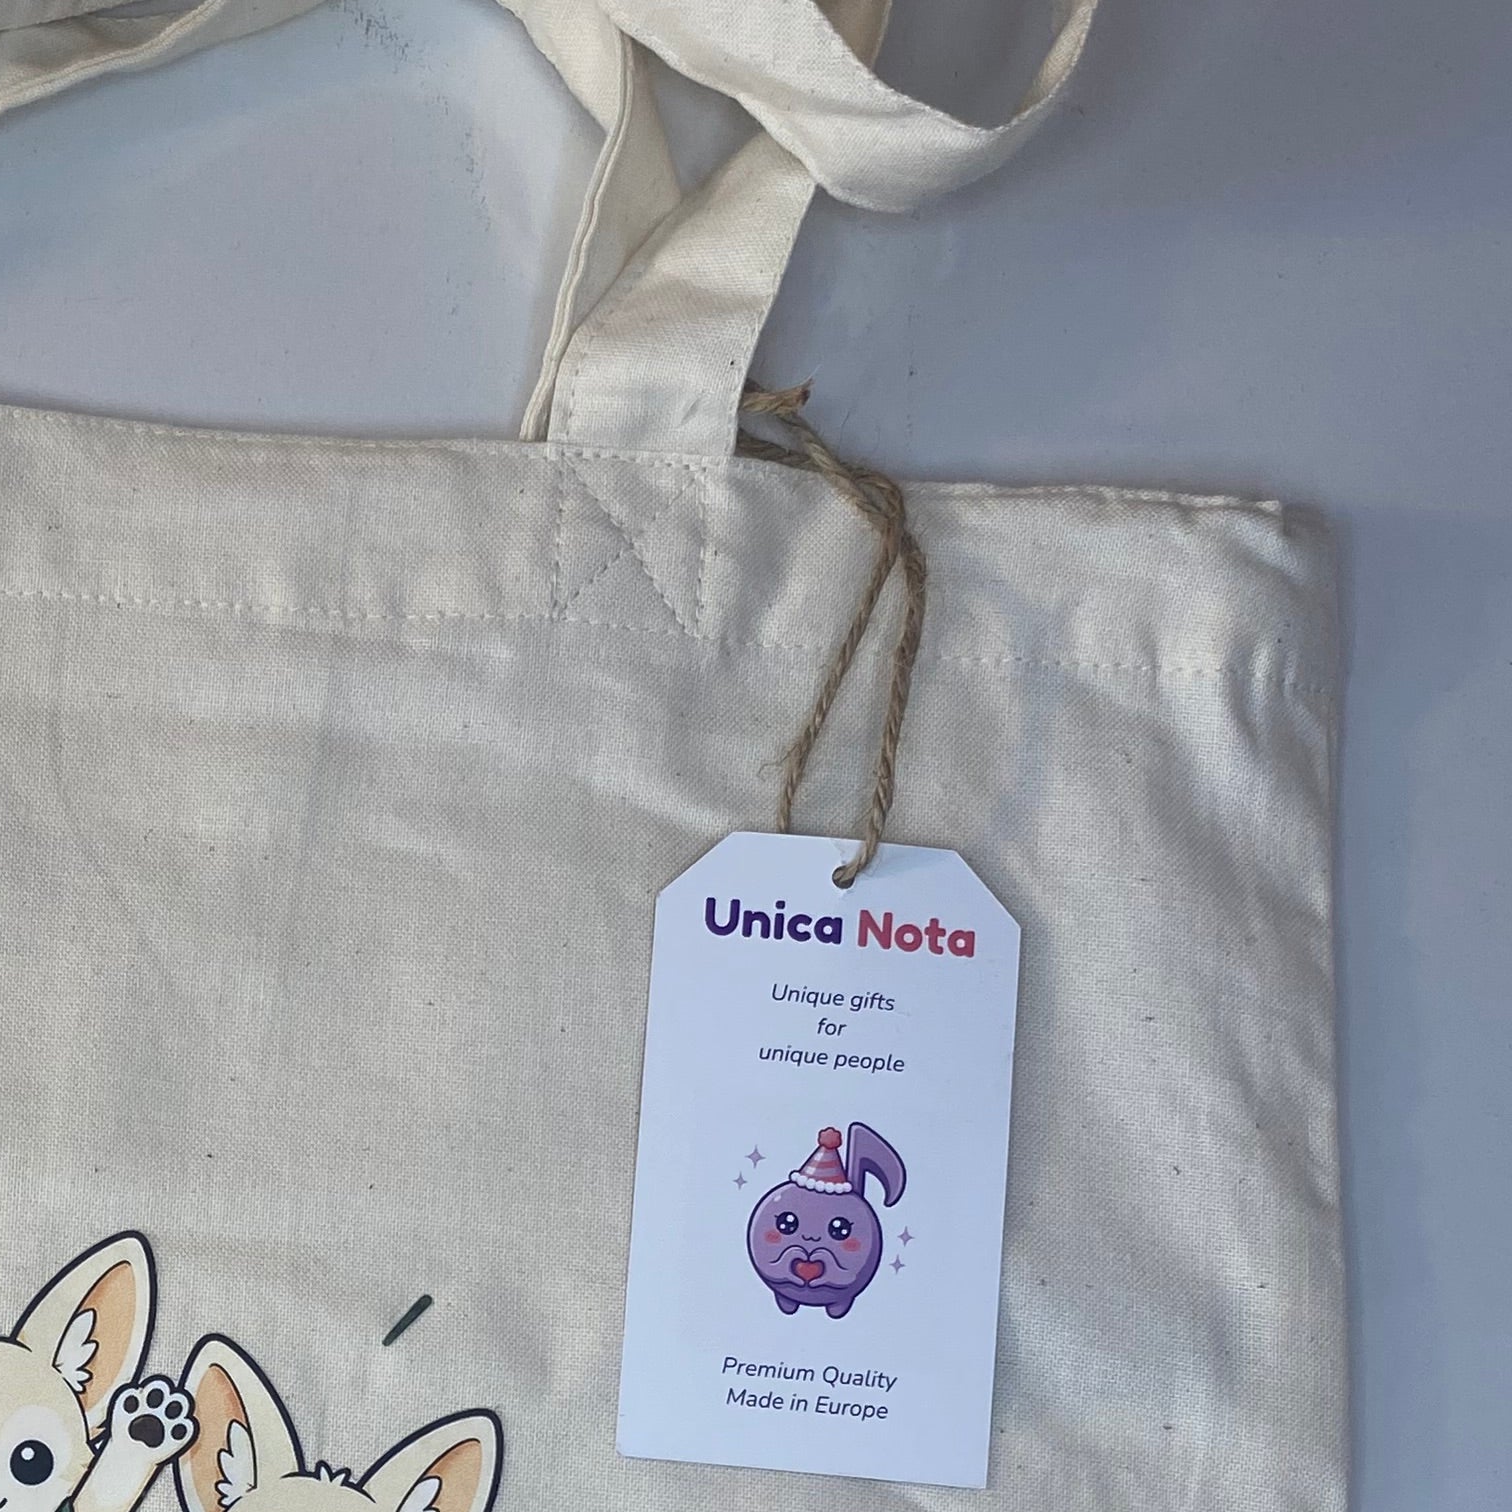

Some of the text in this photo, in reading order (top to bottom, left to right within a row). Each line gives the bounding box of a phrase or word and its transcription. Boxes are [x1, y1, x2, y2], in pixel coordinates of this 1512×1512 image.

[704, 897, 976, 958] Unica Nota
[771, 983, 895, 1012] Unique gifts
[816, 1017, 847, 1036] for
[758, 1046, 905, 1074] unique people
[721, 1356, 898, 1392] Premium Quality
[725, 1388, 889, 1421] Made in Europe
